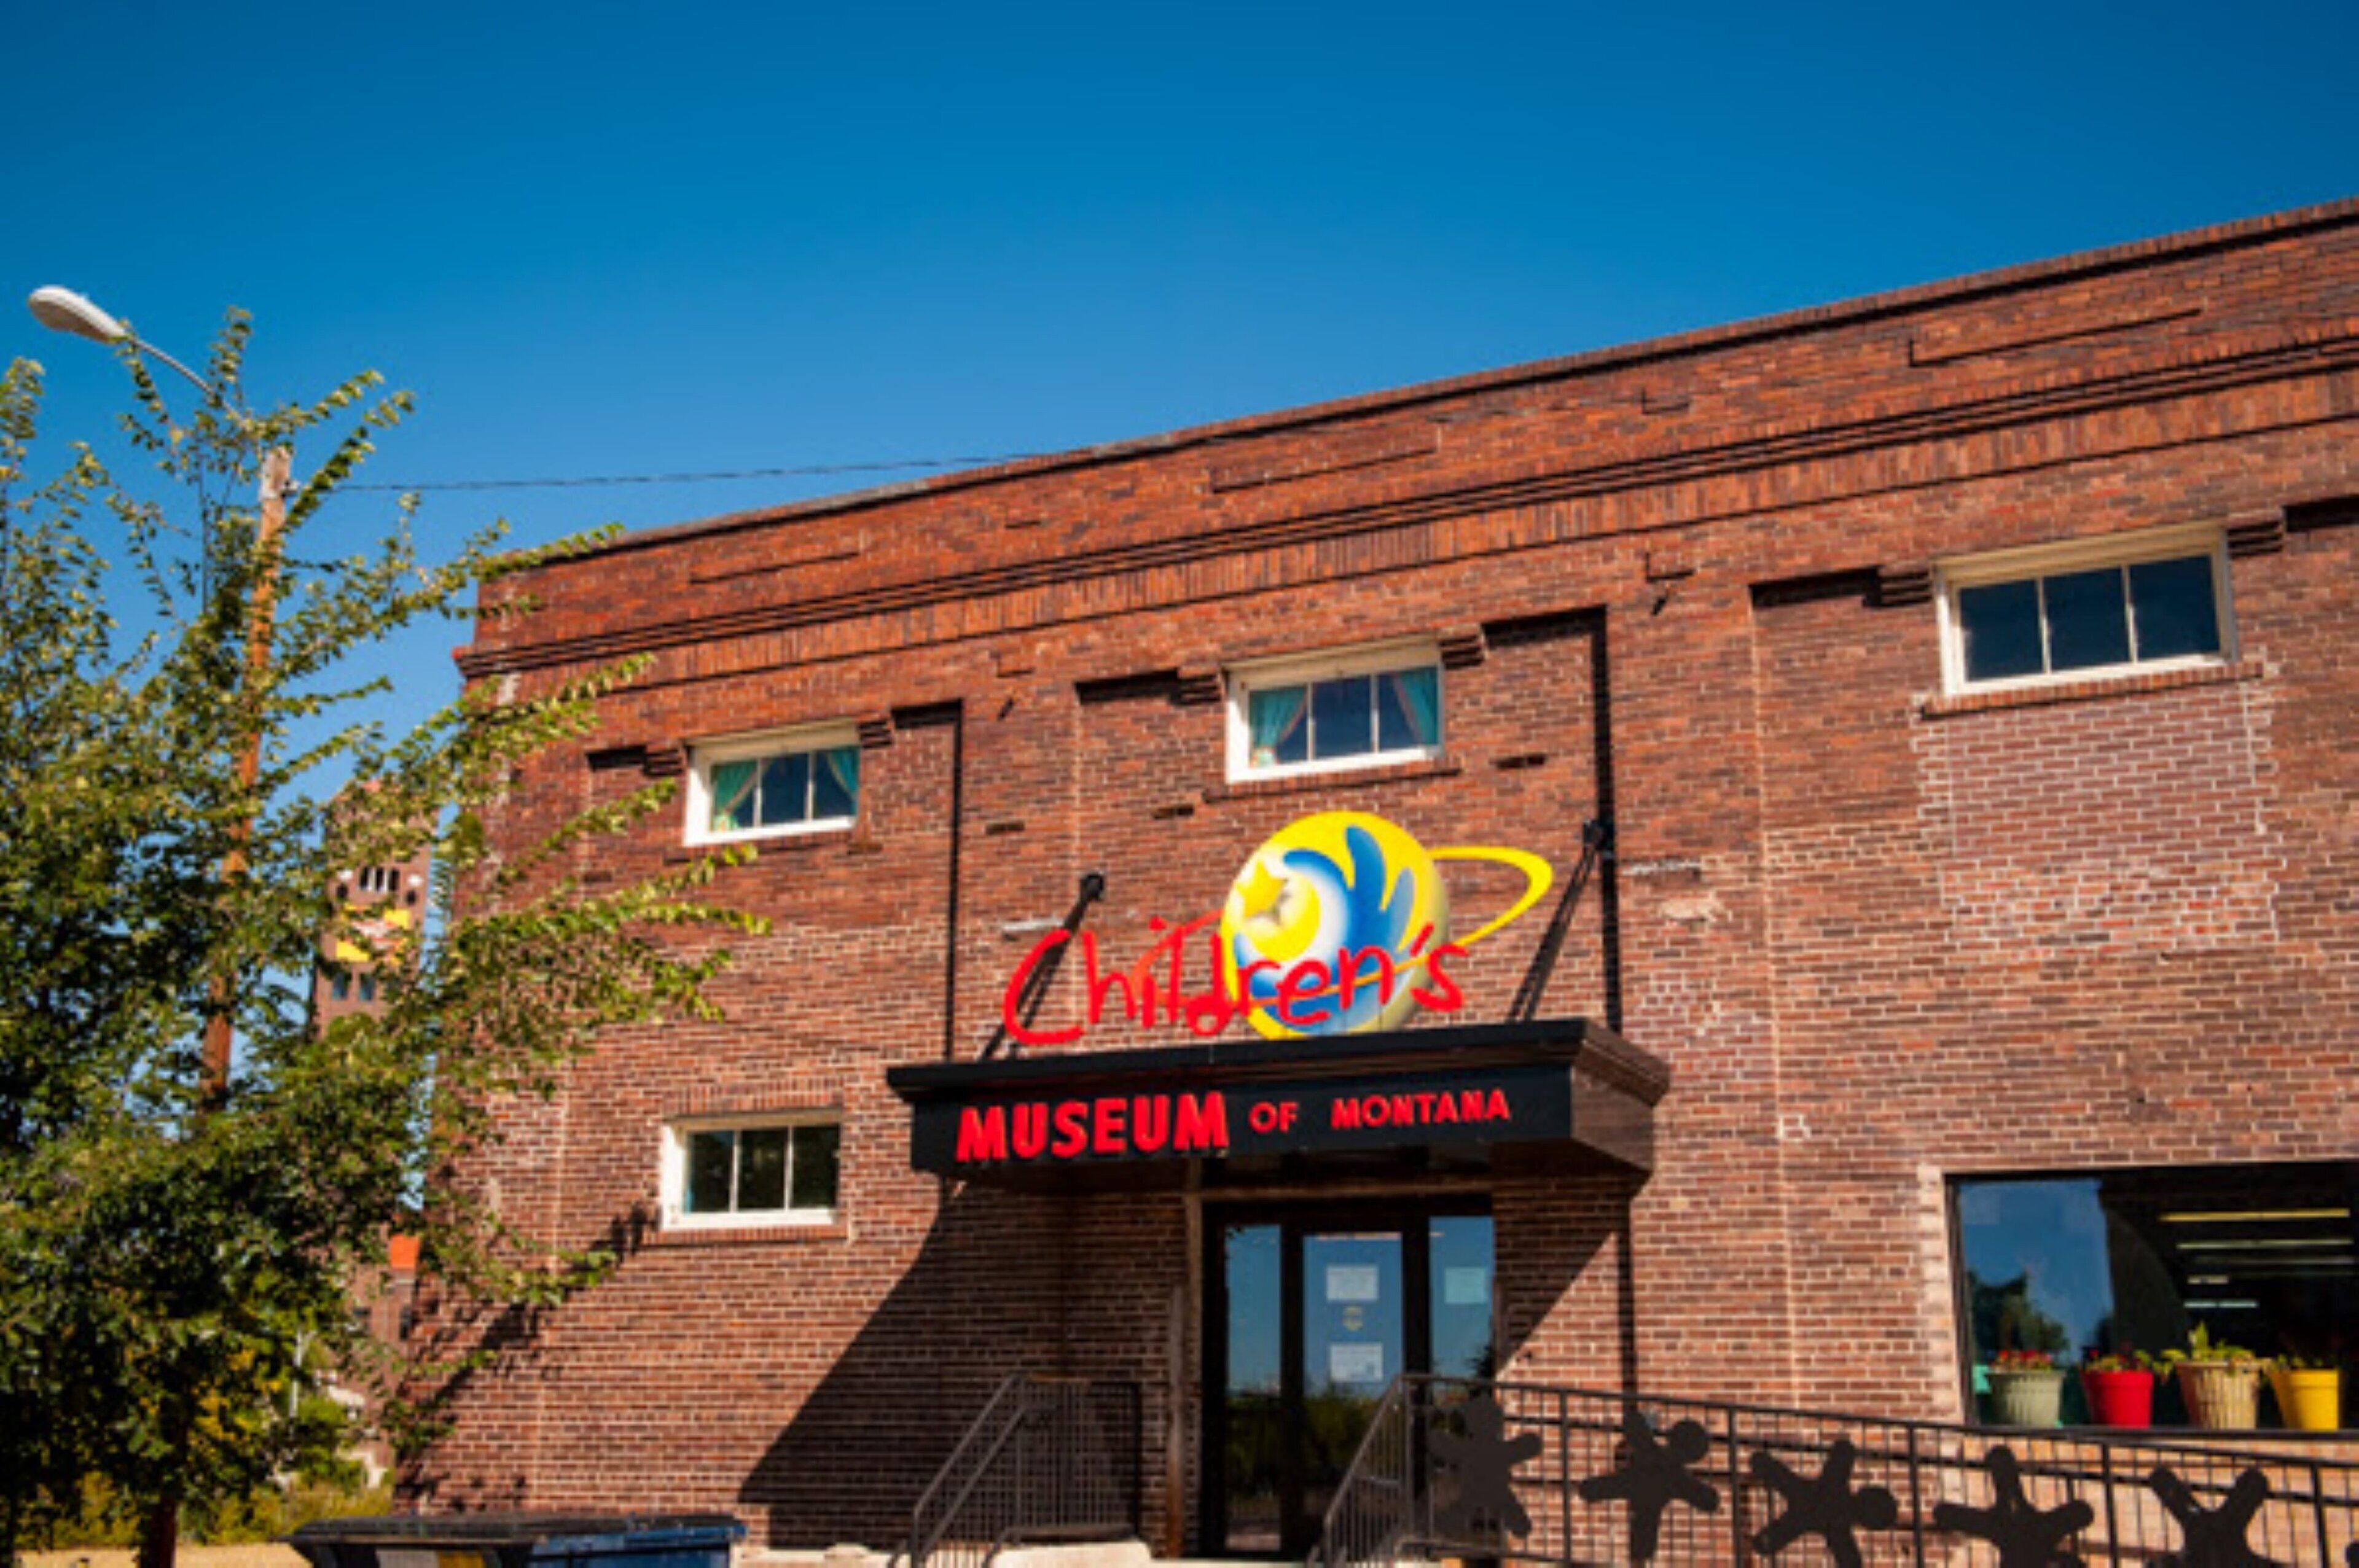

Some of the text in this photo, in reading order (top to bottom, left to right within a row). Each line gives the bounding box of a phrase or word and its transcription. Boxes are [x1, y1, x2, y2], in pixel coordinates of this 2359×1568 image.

[1003, 918, 1467, 1045] Children's
[956, 1089, 1510, 1161] MUSEUM OF MONTANA
